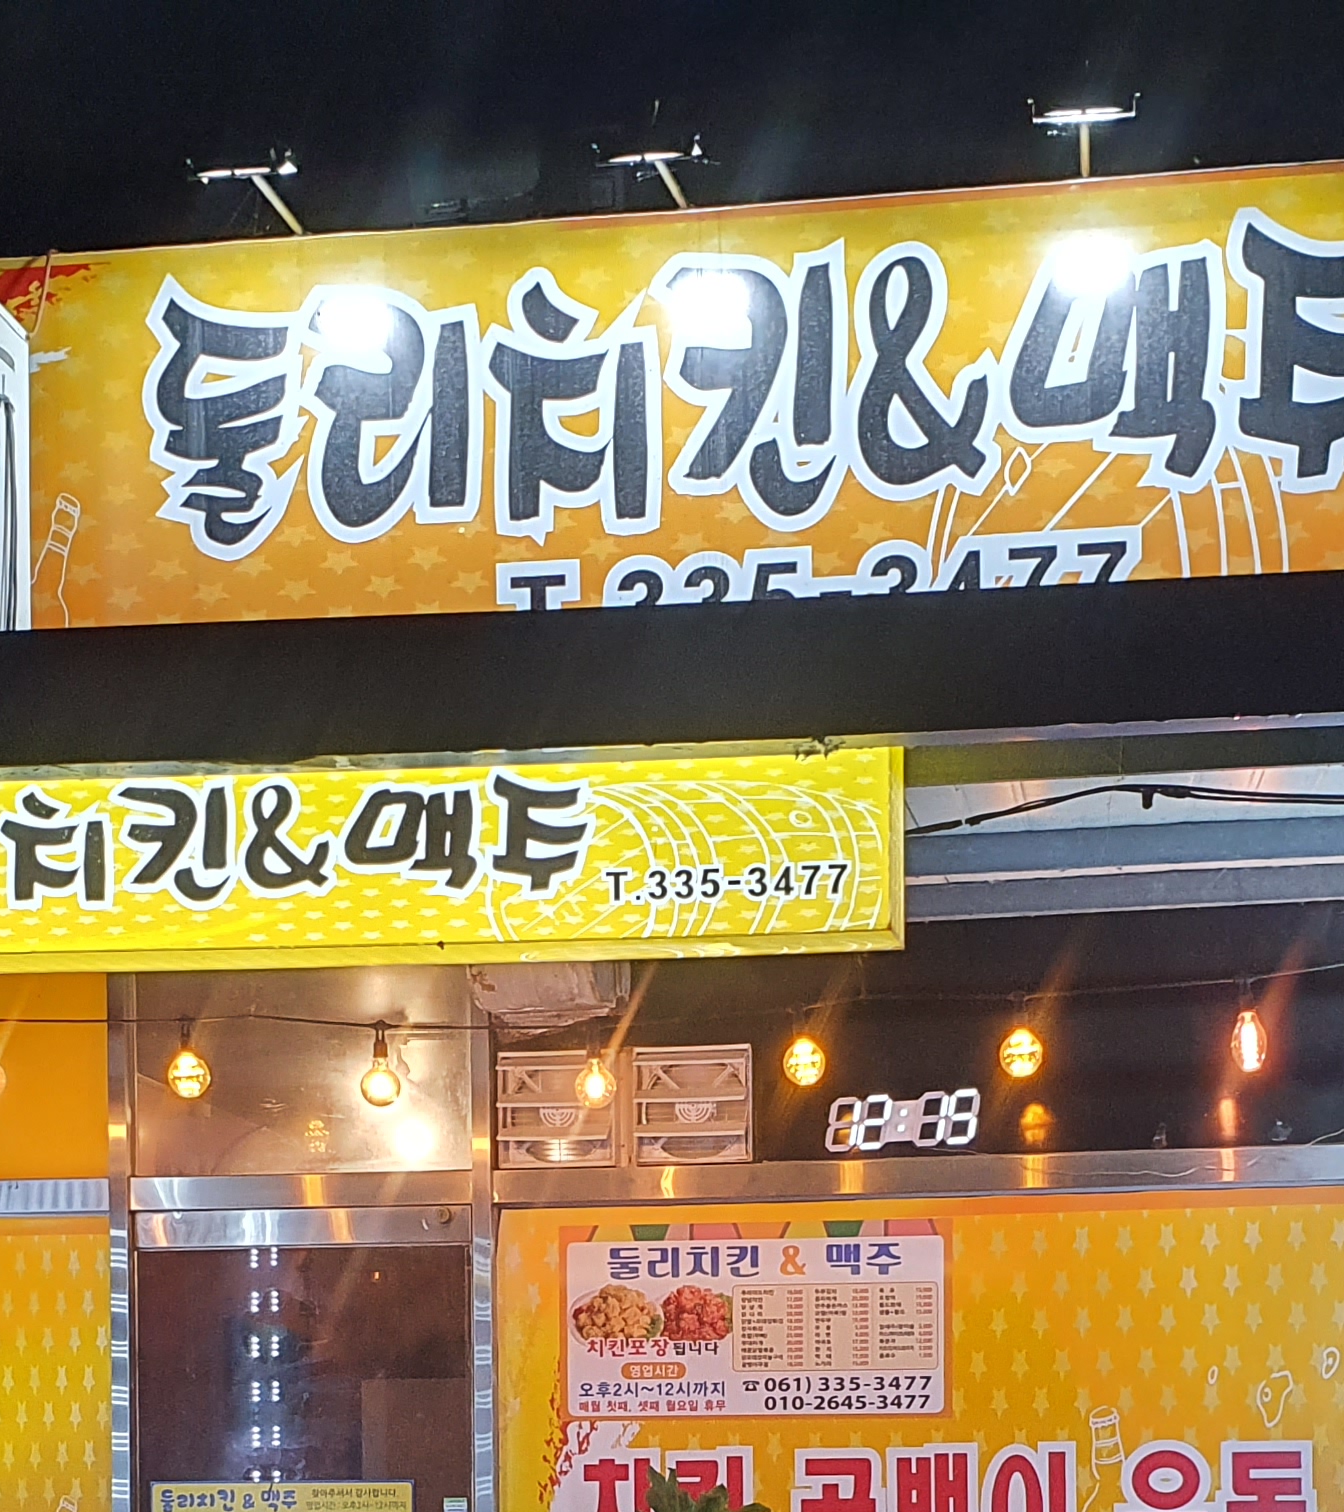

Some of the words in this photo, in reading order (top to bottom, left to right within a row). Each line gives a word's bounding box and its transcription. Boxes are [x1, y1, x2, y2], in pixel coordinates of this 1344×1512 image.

[603, 861, 850, 903] T.335-3477
[606, 1243, 762, 1280] 둘리치킨
[779, 1245, 807, 1277] &
[824, 1241, 903, 1276] 맥주
[586, 1338, 670, 1358] 치킨포장
[672, 1340, 720, 1356] 됩니다
[629, 1364, 680, 1378] 영업시간
[578, 1380, 726, 1398] 오후2시~12시까지
[763, 1376, 812, 1394] 061)
[819, 1374, 932, 1392] 335-3477
[763, 1394, 931, 1412] 010-2645-3477
[242, 1493, 255, 1510] &
